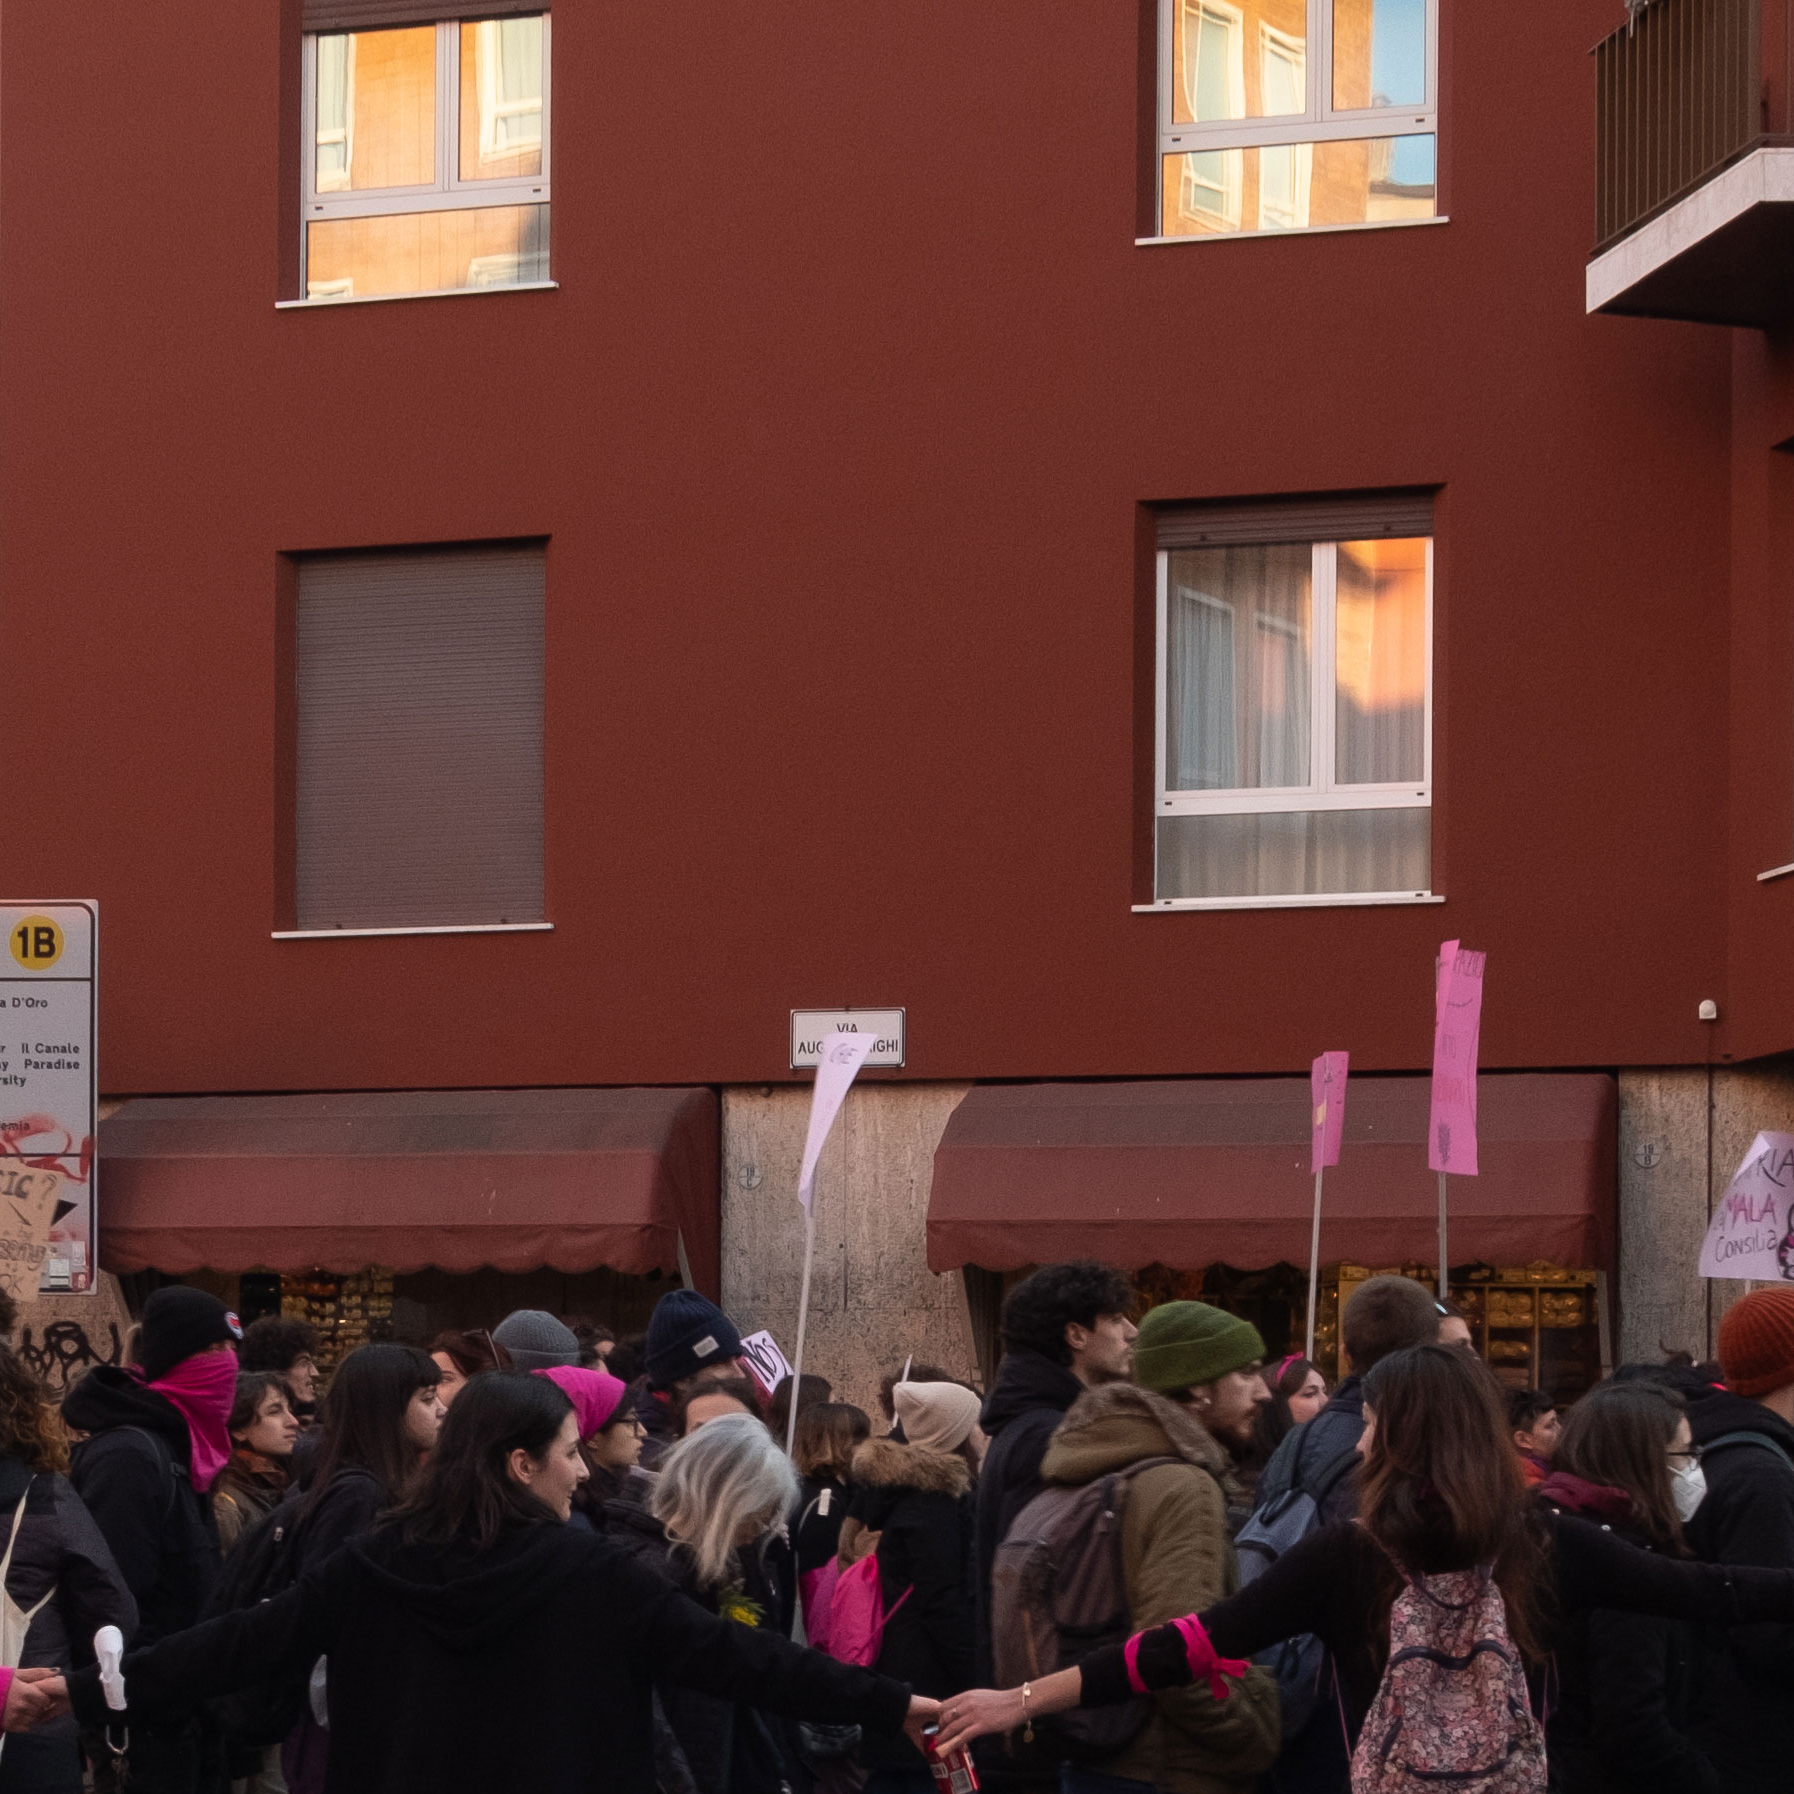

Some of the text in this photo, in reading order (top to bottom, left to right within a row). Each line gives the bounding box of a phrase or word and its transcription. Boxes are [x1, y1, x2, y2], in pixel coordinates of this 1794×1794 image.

[17, 926, 56, 958] 1B
[12, 997, 48, 1008] D'Oro
[836, 1023, 858, 1033] VIA
[35, 1043, 81, 1053] Canale
[869, 1039, 898, 1053] IGHI
[24, 1059, 81, 1070] Paradise
